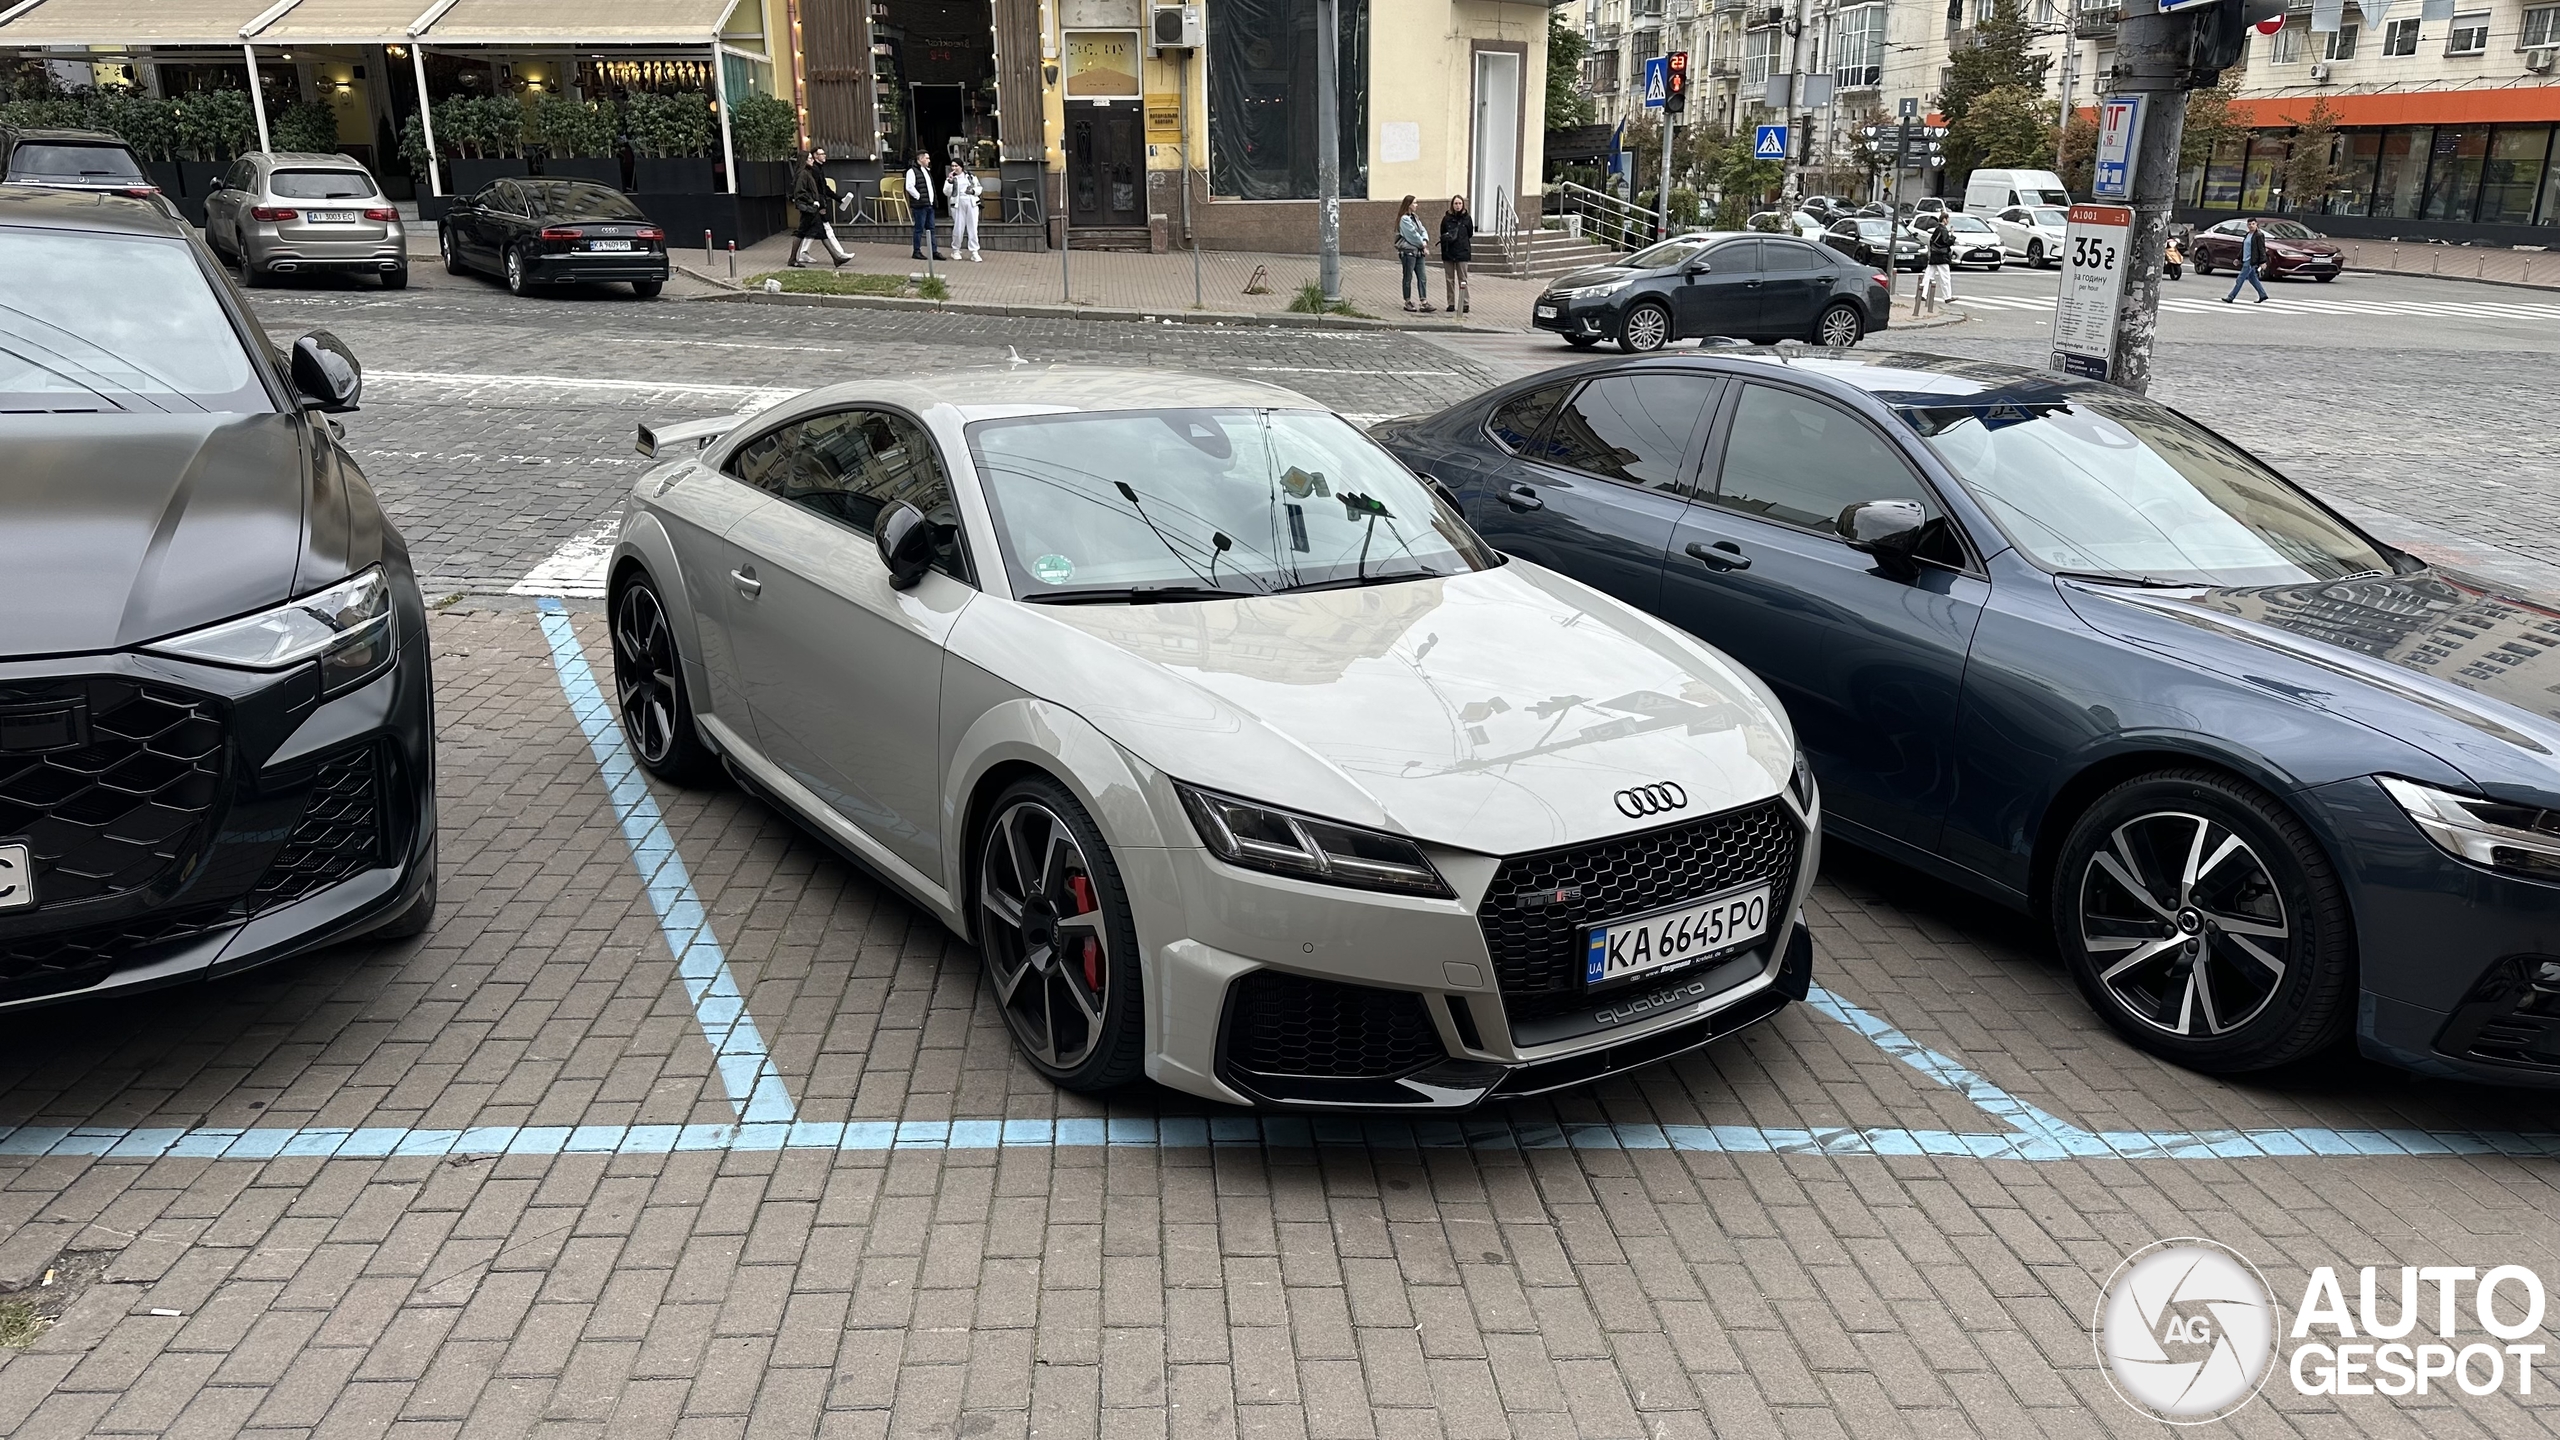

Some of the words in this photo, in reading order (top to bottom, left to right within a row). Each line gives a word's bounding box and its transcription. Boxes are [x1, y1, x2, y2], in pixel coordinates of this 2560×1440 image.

[1671, 56, 1684, 69] 23
[2072, 210, 2097, 220] A1001
[2082, 274, 2107, 285] годину
[1049, 558, 1058, 569] 4
[1607, 926, 1652, 971] KA
[1589, 962, 1602, 975] UA
[1594, 981, 1706, 1024] quattro
